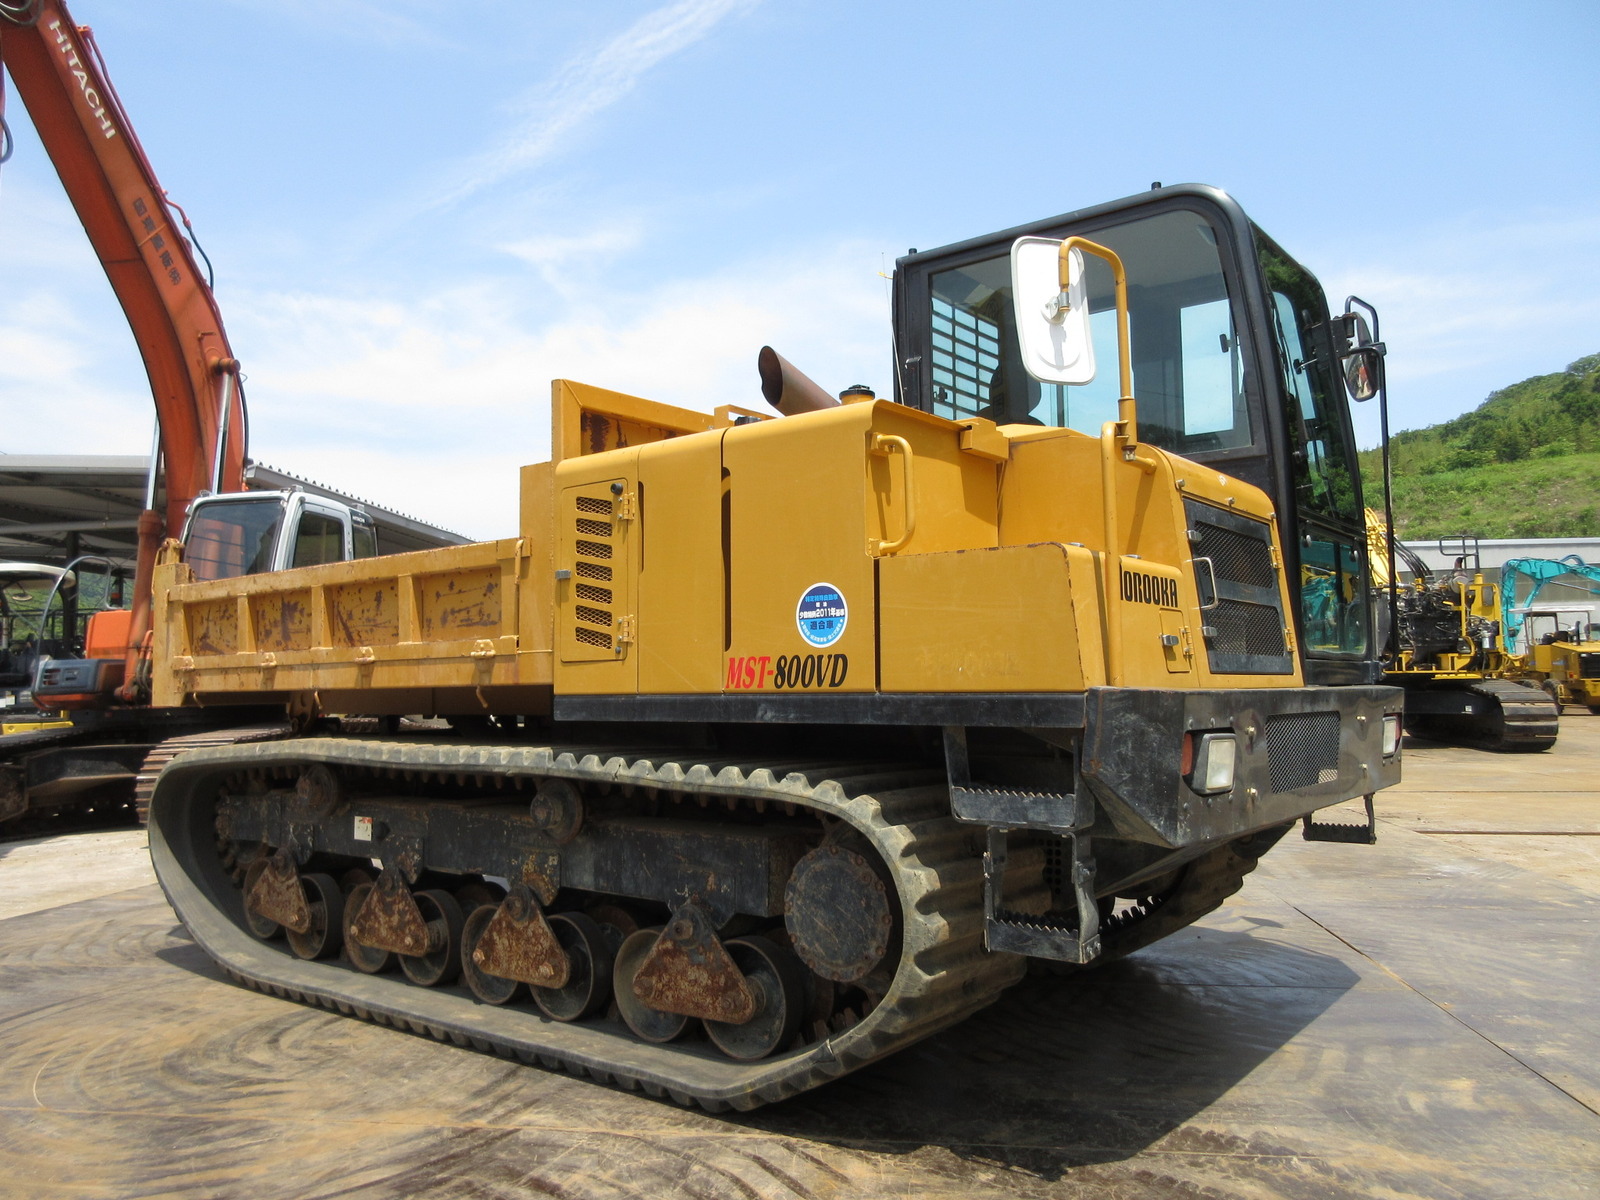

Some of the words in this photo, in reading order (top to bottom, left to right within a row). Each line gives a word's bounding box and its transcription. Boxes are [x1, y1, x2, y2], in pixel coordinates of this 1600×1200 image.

[49, 20, 116, 139] HITACHI
[1119, 570, 1178, 608] OROOKA
[725, 653, 848, 690] MST-800VD
